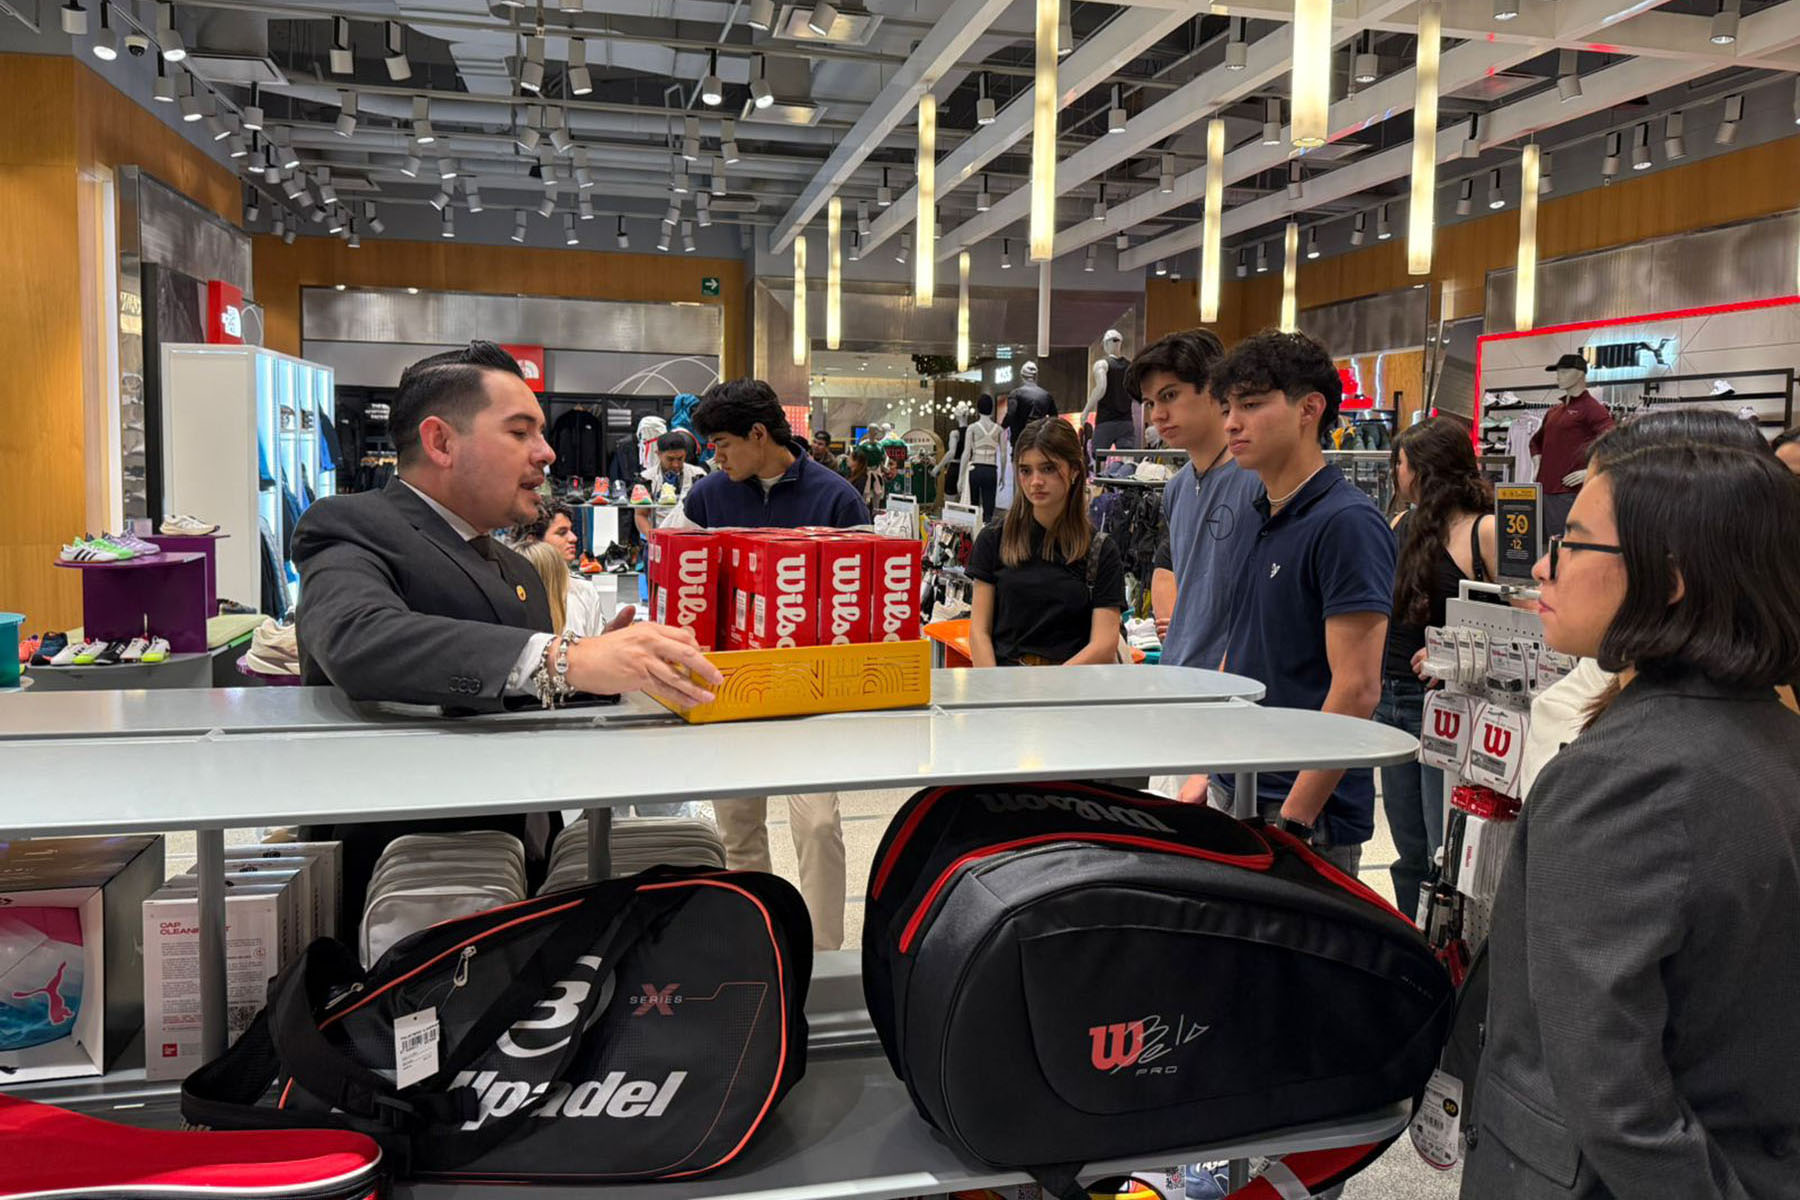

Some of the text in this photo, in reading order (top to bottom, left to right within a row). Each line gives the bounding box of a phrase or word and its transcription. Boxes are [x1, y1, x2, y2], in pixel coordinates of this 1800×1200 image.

[1506, 514, 1529, 534] 30
[677, 547, 711, 652] Wils
[776, 553, 806, 650] Wilso
[832, 553, 860, 647] Wilso
[629, 995, 683, 1004] SERIES
[1136, 1066, 1178, 1076] PRO
